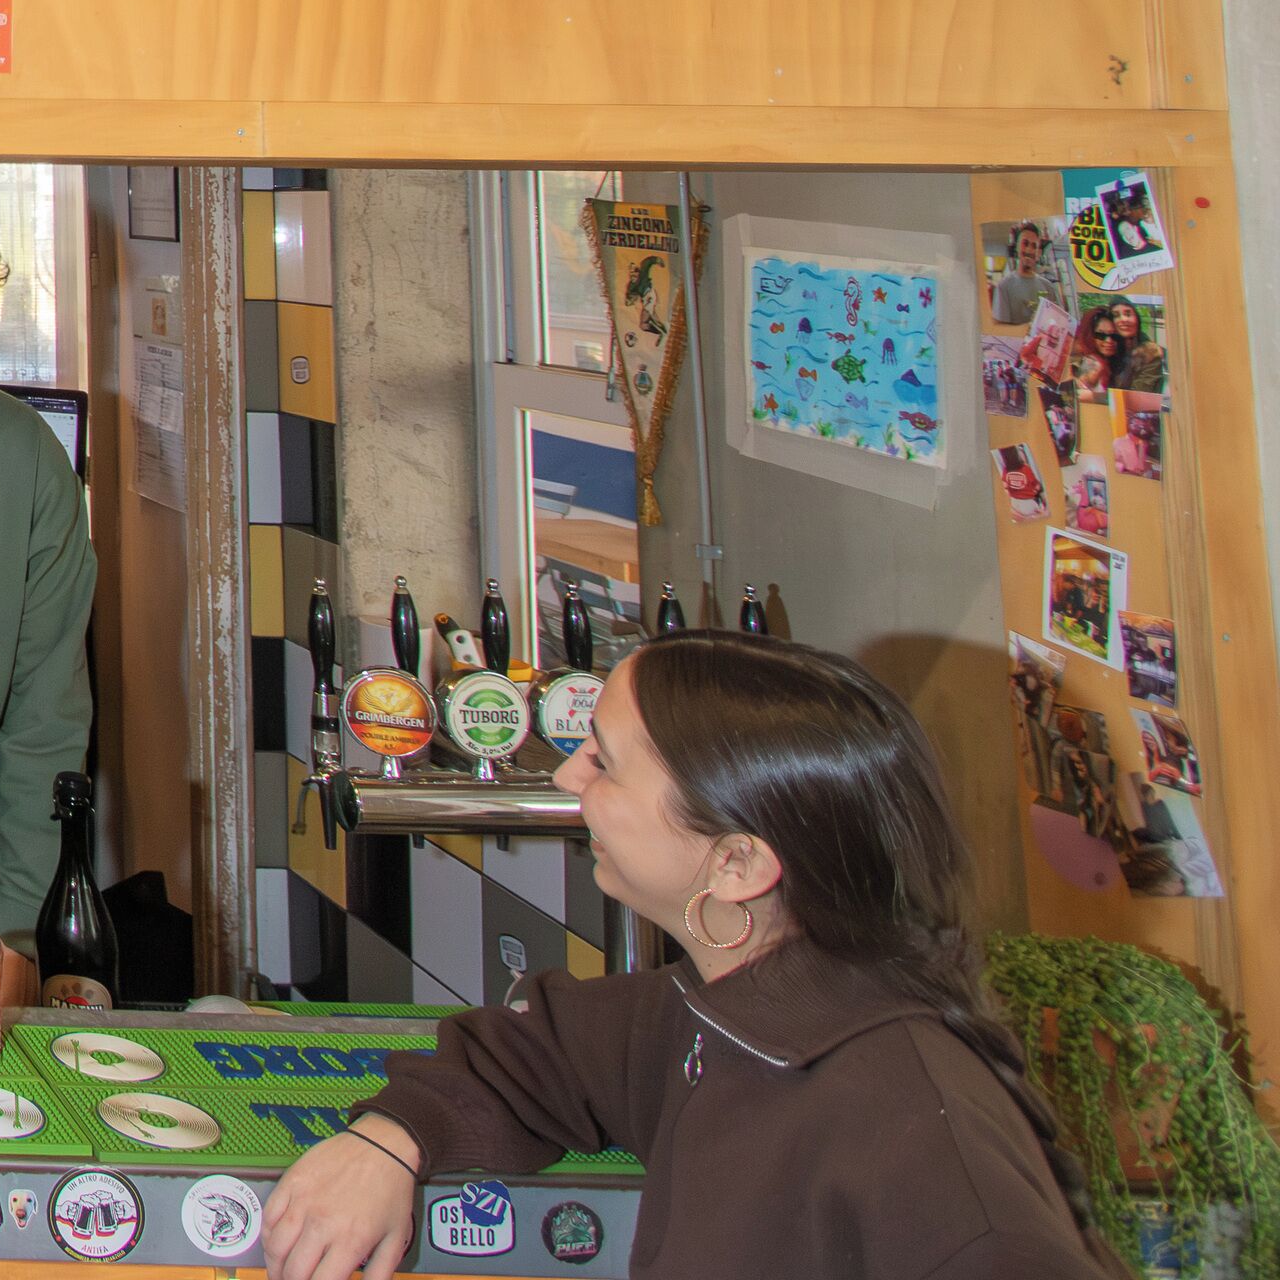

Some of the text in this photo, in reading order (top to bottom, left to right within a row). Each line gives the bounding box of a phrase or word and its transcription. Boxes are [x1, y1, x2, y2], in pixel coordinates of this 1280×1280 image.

[355, 710, 425, 728] GRIMBERGEN
[460, 710, 519, 725] TUBORG
[555, 720, 593, 731] BLA
[68, 1175, 125, 1194] UN ALTRO ADESIVO
[450, 1228, 495, 1246] BELLO
[81, 1244, 109, 1254] ANTIFA
